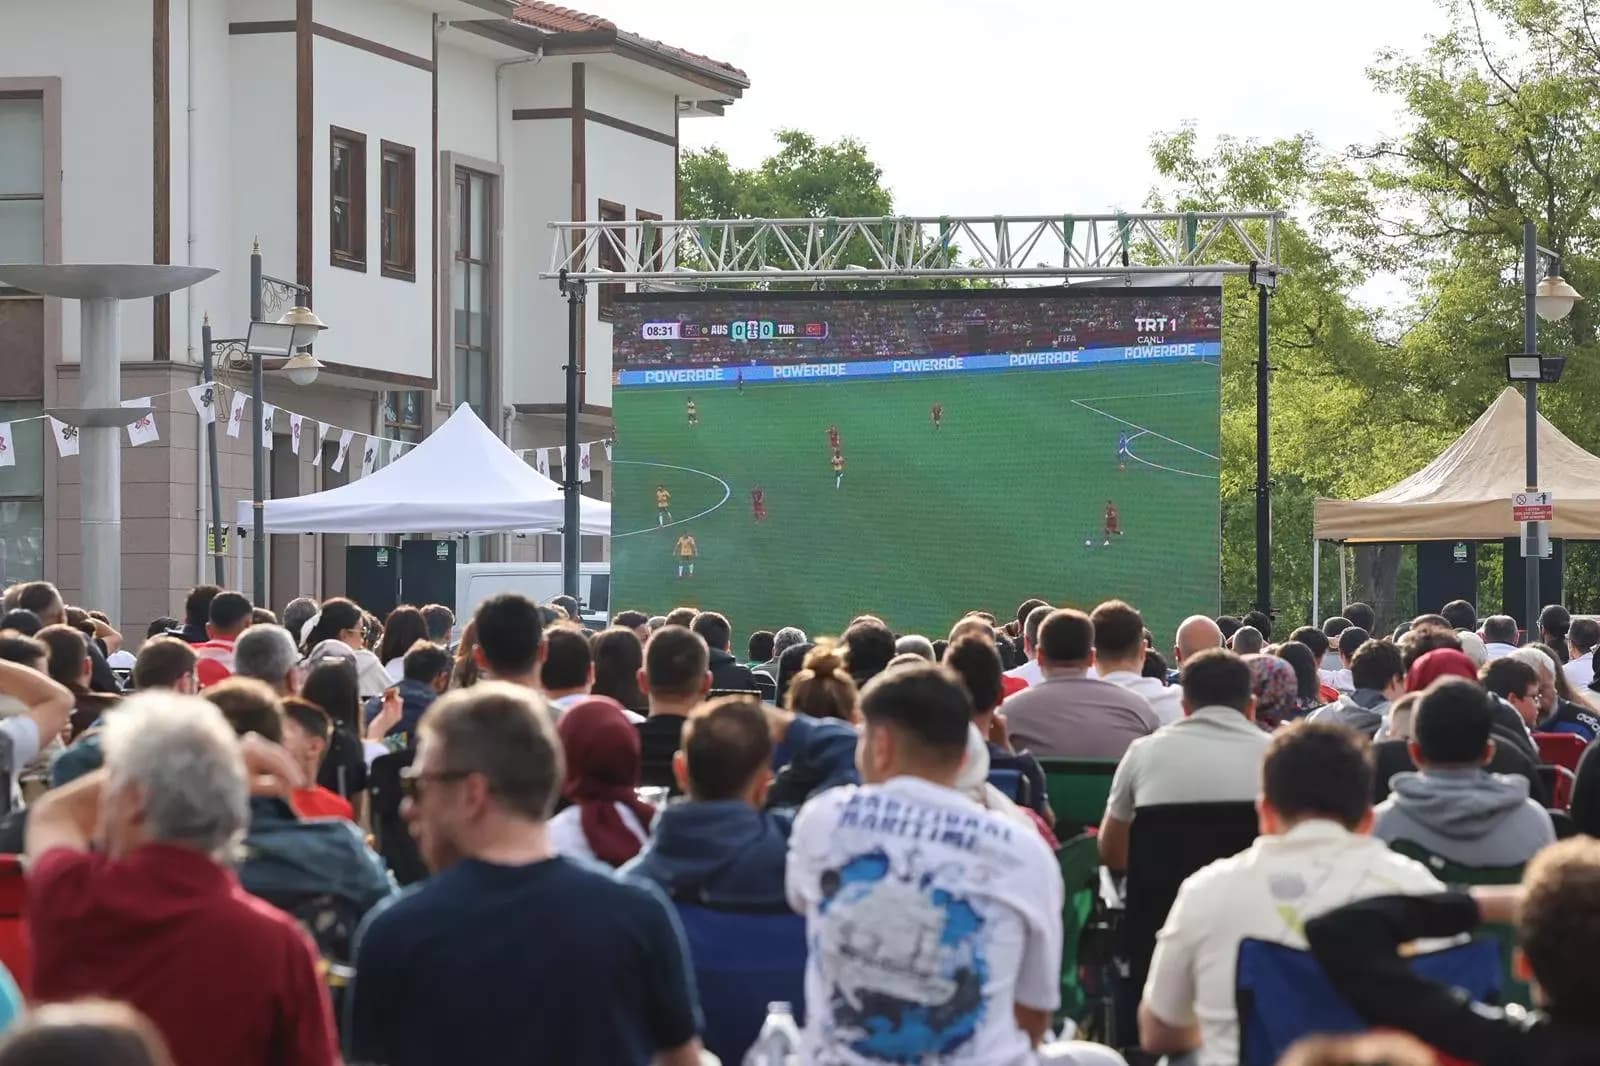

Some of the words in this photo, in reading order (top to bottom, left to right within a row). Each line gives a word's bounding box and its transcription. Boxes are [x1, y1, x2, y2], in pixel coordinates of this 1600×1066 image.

[646, 326, 674, 336] 08:31
[710, 324, 728, 335] AUS
[778, 324, 795, 335] TUR
[1135, 318, 1167, 332] TRT
[1169, 318, 1177, 332] 1
[1137, 336, 1165, 344] CANLI
[644, 368, 724, 383] POWERADE
[773, 362, 847, 378] POWERADE
[893, 357, 963, 373] POWERADE
[1009, 350, 1079, 366] POWERADE
[1124, 343, 1196, 359] POWERADE
